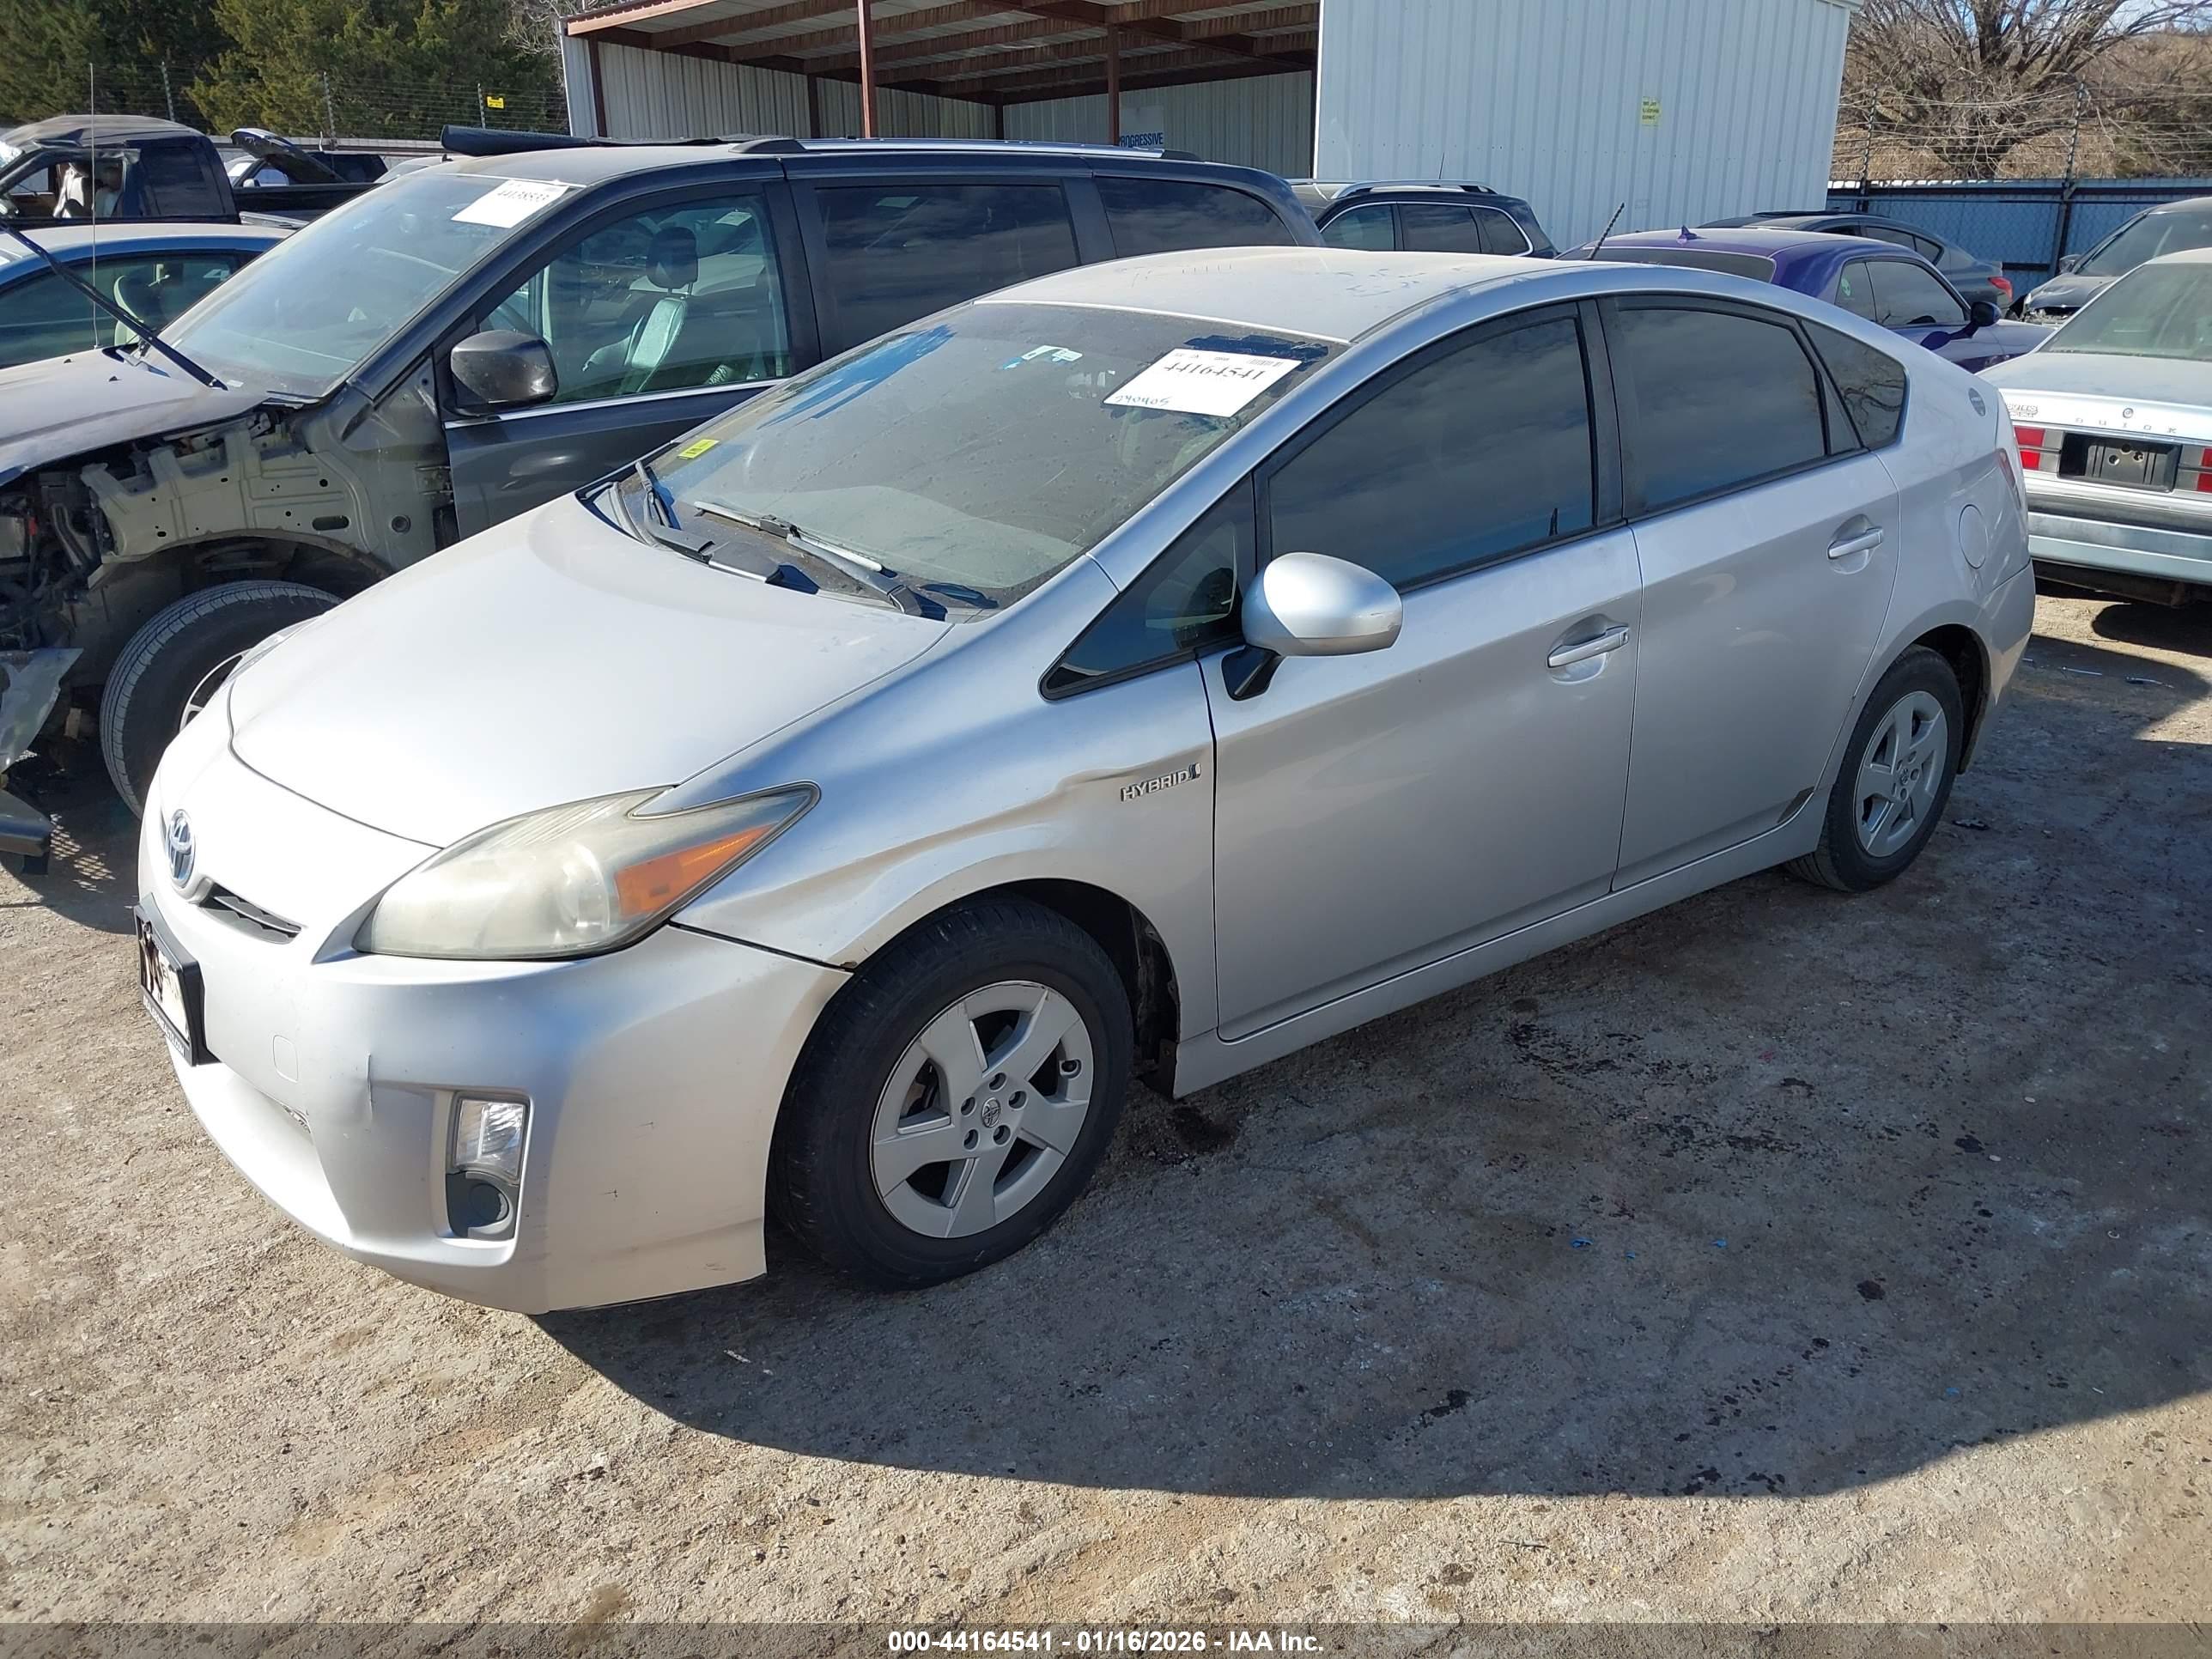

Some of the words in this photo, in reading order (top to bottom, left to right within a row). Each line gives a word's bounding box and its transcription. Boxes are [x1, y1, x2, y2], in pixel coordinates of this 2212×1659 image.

[1120, 132, 1164, 147] ROGRESSIVE
[1164, 362, 1267, 380] 44164541
[1120, 769, 1189, 802] HYBRID
